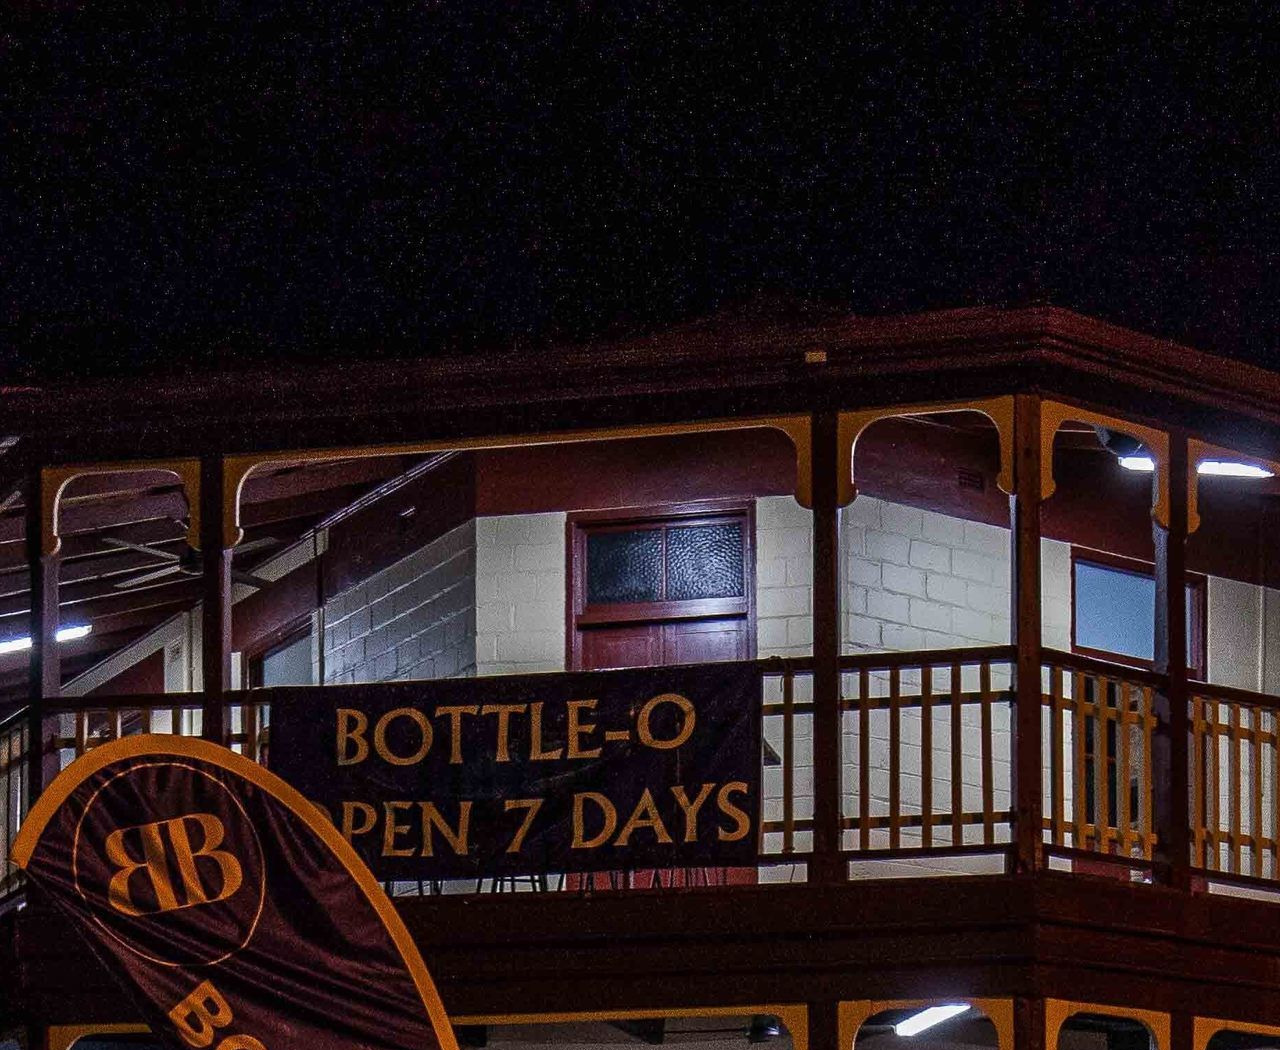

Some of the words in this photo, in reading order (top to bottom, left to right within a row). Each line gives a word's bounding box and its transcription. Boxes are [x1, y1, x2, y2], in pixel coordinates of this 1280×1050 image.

[336, 692, 697, 767] BOTTLE-O
[323, 800, 473, 858] PEN
[505, 798, 545, 854] 7
[571, 781, 751, 850] DAYS
